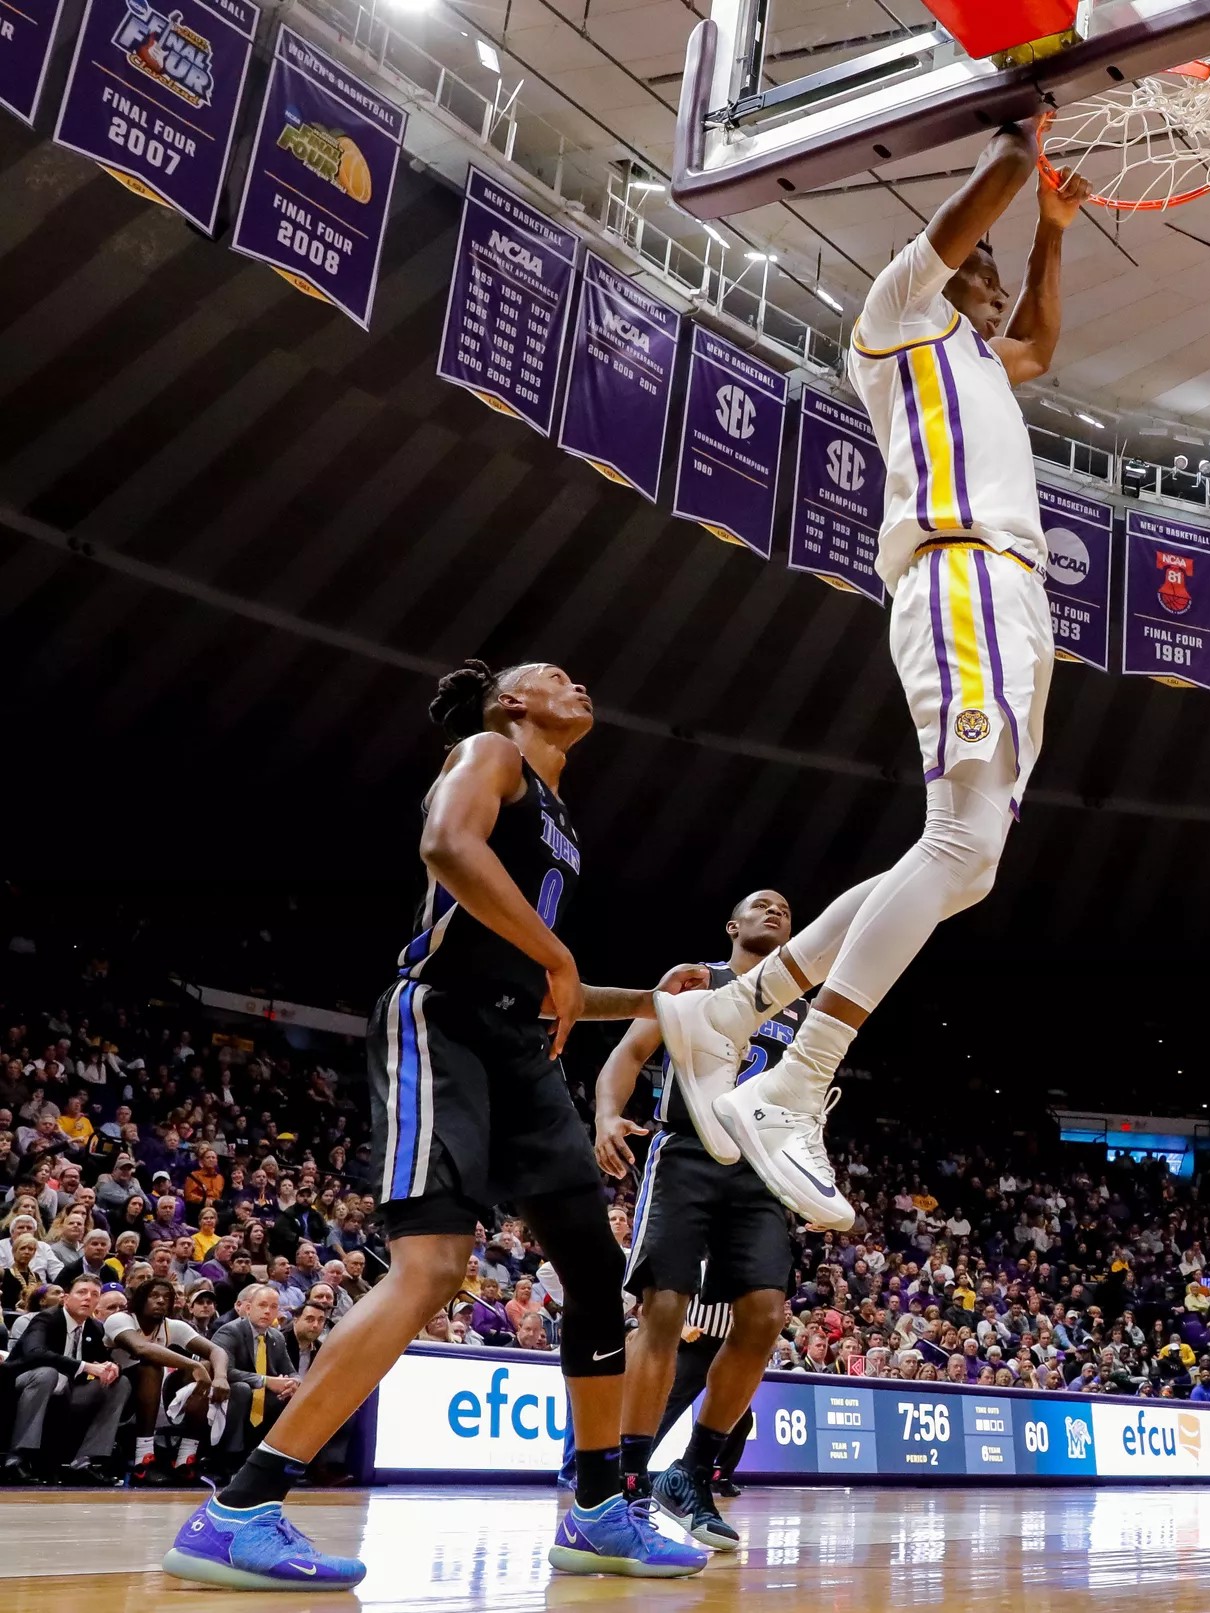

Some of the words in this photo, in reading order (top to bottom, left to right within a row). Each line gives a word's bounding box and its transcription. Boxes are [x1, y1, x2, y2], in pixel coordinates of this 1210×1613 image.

[288, 42, 334, 84] WOMEN'S
[337, 78, 394, 128] BASKETBALL
[102, 87, 148, 128] FINAL
[153, 119, 197, 157] FOUR
[107, 116, 181, 175] 2007
[273, 193, 312, 231] FINAL
[317, 222, 353, 256] FOUR
[484, 187, 511, 213] MEN'S
[512, 206, 562, 247] BASKETBALL
[276, 220, 341, 276] 2008
[488, 229, 543, 278] NCAA
[471, 240, 514, 272] TOURNAMENT
[514, 269, 559, 300] APPEARANCES
[468, 282, 490, 304] 1980
[499, 301, 519, 321] 1981
[527, 318, 549, 338] 1984
[471, 265, 493, 287] 1953
[501, 284, 523, 305] 1954
[530, 302, 551, 323] 1979
[598, 269, 622, 294] MEN'S
[623, 287, 667, 323] BASKETBALL
[495, 317, 517, 338] 1986
[526, 335, 546, 355] 1987
[604, 308, 650, 354] NCAA
[460, 332, 481, 353] 1991
[490, 350, 513, 371] 1992
[520, 367, 542, 388] 1993
[493, 334, 515, 354] 1989
[523, 351, 543, 371] 1990
[588, 343, 609, 364] 2006
[613, 360, 634, 380] 2009
[639, 377, 657, 396] 2015
[706, 342, 730, 363] MEN'S
[731, 357, 775, 389] BASKETBALL
[457, 350, 483, 372] 2000
[486, 367, 511, 388] 2003
[515, 384, 539, 405] 2005
[715, 384, 757, 440] SEC
[815, 400, 839, 419] MEN'S
[840, 412, 875, 436] BASKETB
[693, 429, 734, 457] TOURNAMENT
[734, 451, 769, 476] CHAMPIONS
[693, 459, 713, 477] 1980
[826, 439, 866, 491] SEC
[819, 487, 868, 517] CHAMPIONS
[1037, 489, 1055, 504] EN'S
[1057, 497, 1101, 518] BASKETBALL
[805, 524, 824, 540] 1979
[807, 509, 825, 525] 1935
[832, 521, 851, 536] 1953
[857, 532, 875, 547] 1954
[1140, 521, 1164, 533] MEN'S
[1165, 527, 1210, 545] BASKETBALL
[804, 539, 821, 554] 1991
[829, 550, 849, 566] 2000
[853, 560, 873, 576] 2006
[1048, 551, 1087, 576] NCAA
[1162, 553, 1187, 567] NCAA
[1167, 570, 1182, 585] 81
[1064, 606, 1090, 623] FOUR
[1144, 626, 1173, 643] FINAL
[1175, 633, 1203, 649] FOUR
[1155, 642, 1191, 666] 1981
[536, 868, 564, 930] 0
[736, 1044, 768, 1087] 2
[830, 1398, 844, 1406] TIME
[844, 1398, 859, 1407] OUTS
[975, 1406, 987, 1414] TIME
[775, 1408, 807, 1446] 68
[898, 1402, 950, 1442] 7:56
[1024, 1421, 1048, 1452] 60
[1122, 1410, 1176, 1457] efcu
[830, 1450, 848, 1459] FOULS
[832, 1442, 847, 1450] TEAM
[852, 1441, 860, 1460] 7
[906, 1454, 928, 1463] PERIOD
[930, 1448, 939, 1466] 2
[982, 1445, 989, 1462] 6
